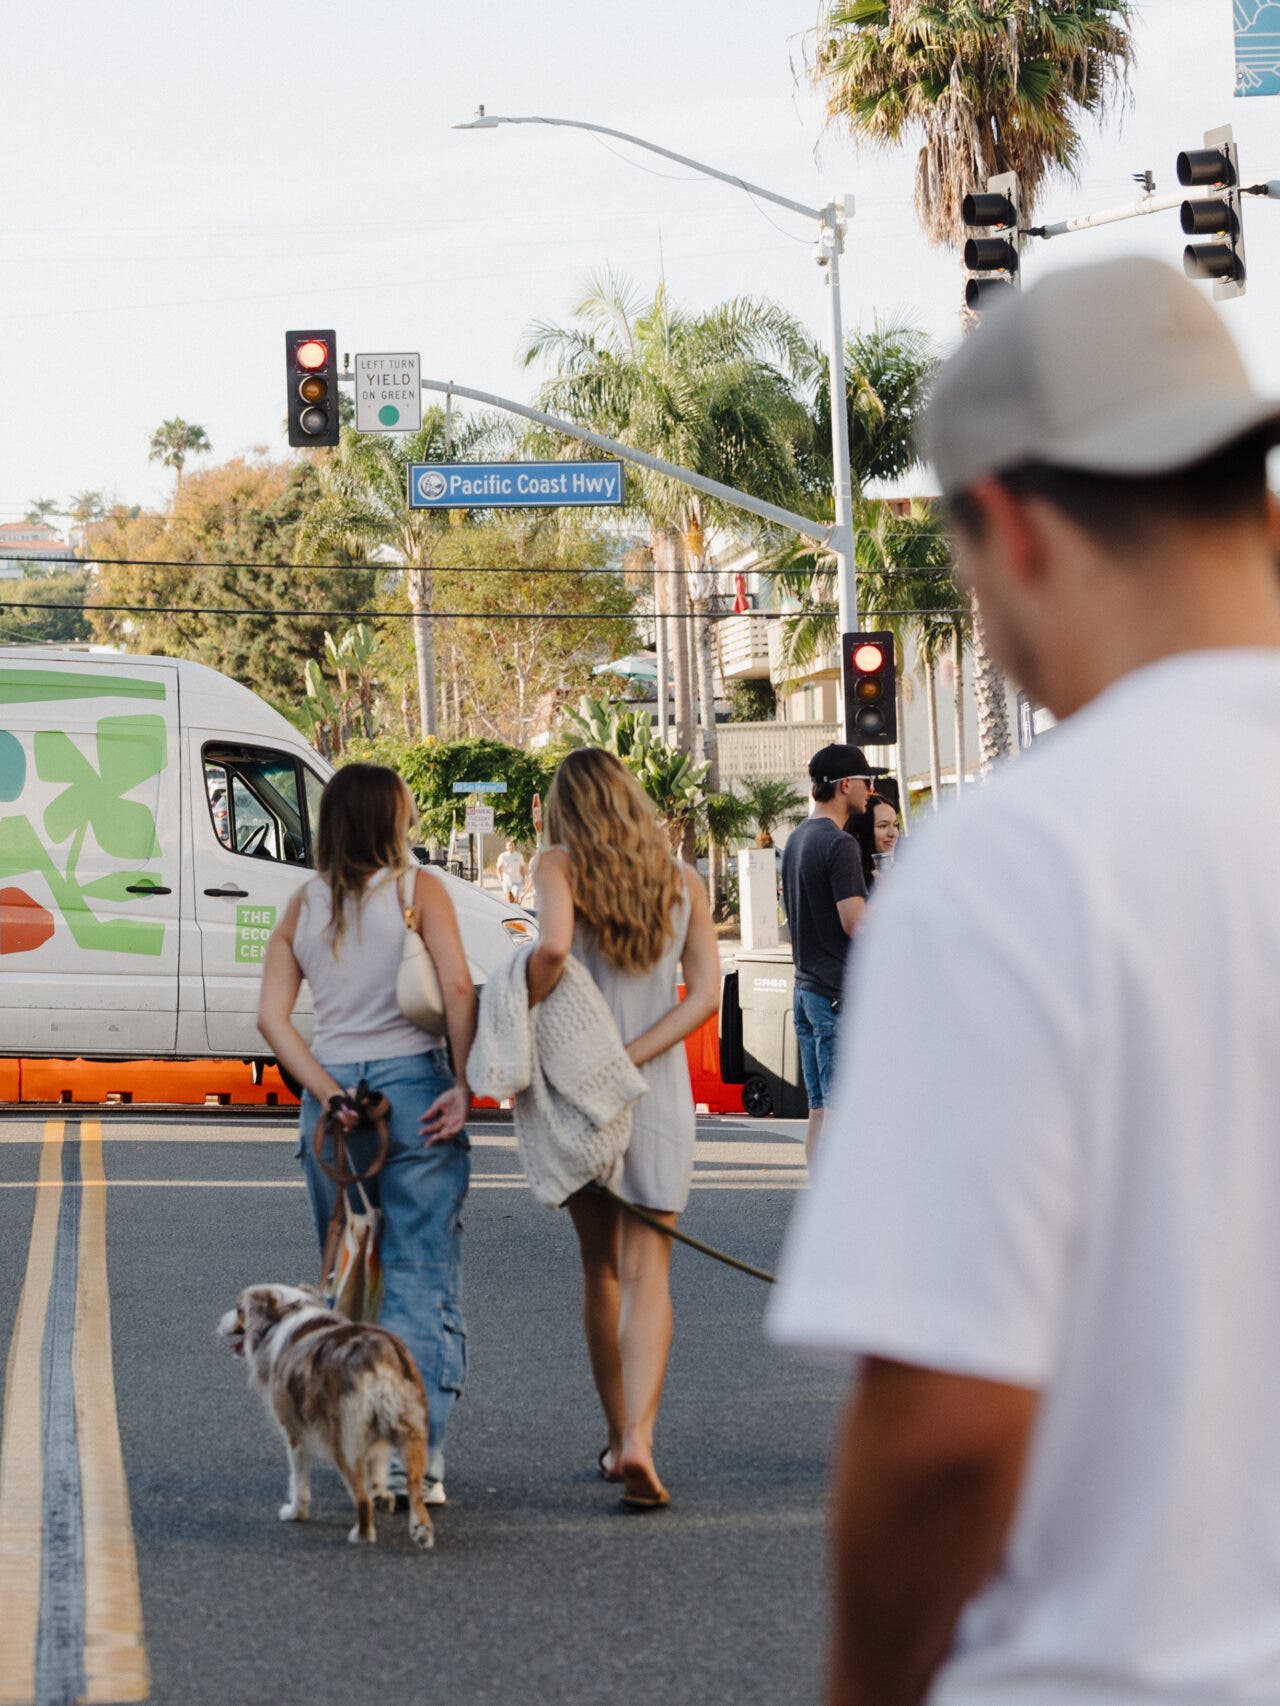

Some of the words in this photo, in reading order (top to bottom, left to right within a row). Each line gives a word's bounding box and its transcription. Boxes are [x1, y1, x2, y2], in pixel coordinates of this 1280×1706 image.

[361, 360, 384, 369] LEFT
[389, 359, 415, 369] TURN
[366, 373, 411, 386] YIELD
[362, 391, 375, 400] ON
[381, 390, 415, 400] GREEN
[449, 474, 511, 495] Pacific
[517, 473, 567, 494] Coast
[572, 473, 616, 498] Hwy
[241, 911, 271, 924] THE
[241, 928, 270, 941] ECO
